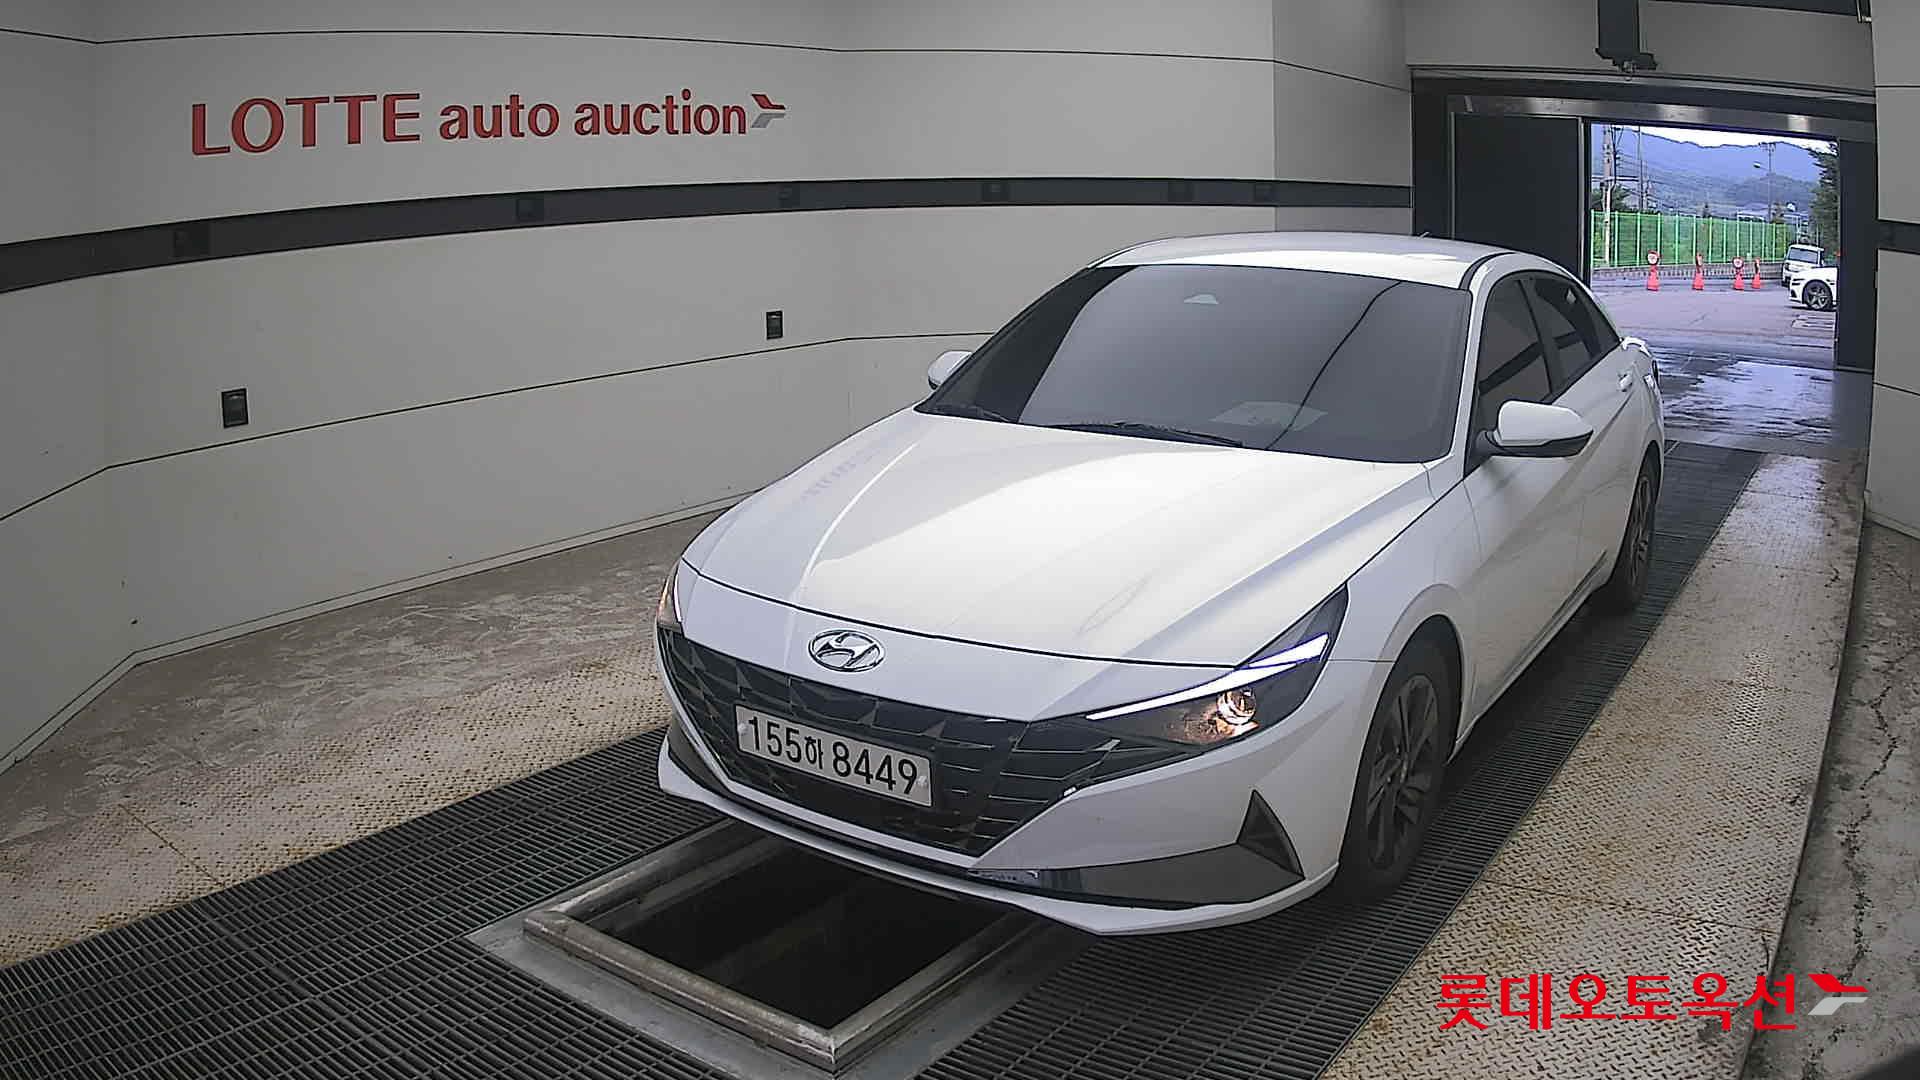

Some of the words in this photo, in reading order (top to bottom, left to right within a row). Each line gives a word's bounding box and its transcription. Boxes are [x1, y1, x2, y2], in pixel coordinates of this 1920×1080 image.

[191, 93, 421, 156] LOTTE
[438, 94, 560, 140] auto
[573, 89, 747, 136] auction
[748, 716, 824, 770] 155하
[831, 741, 919, 795] 8449
